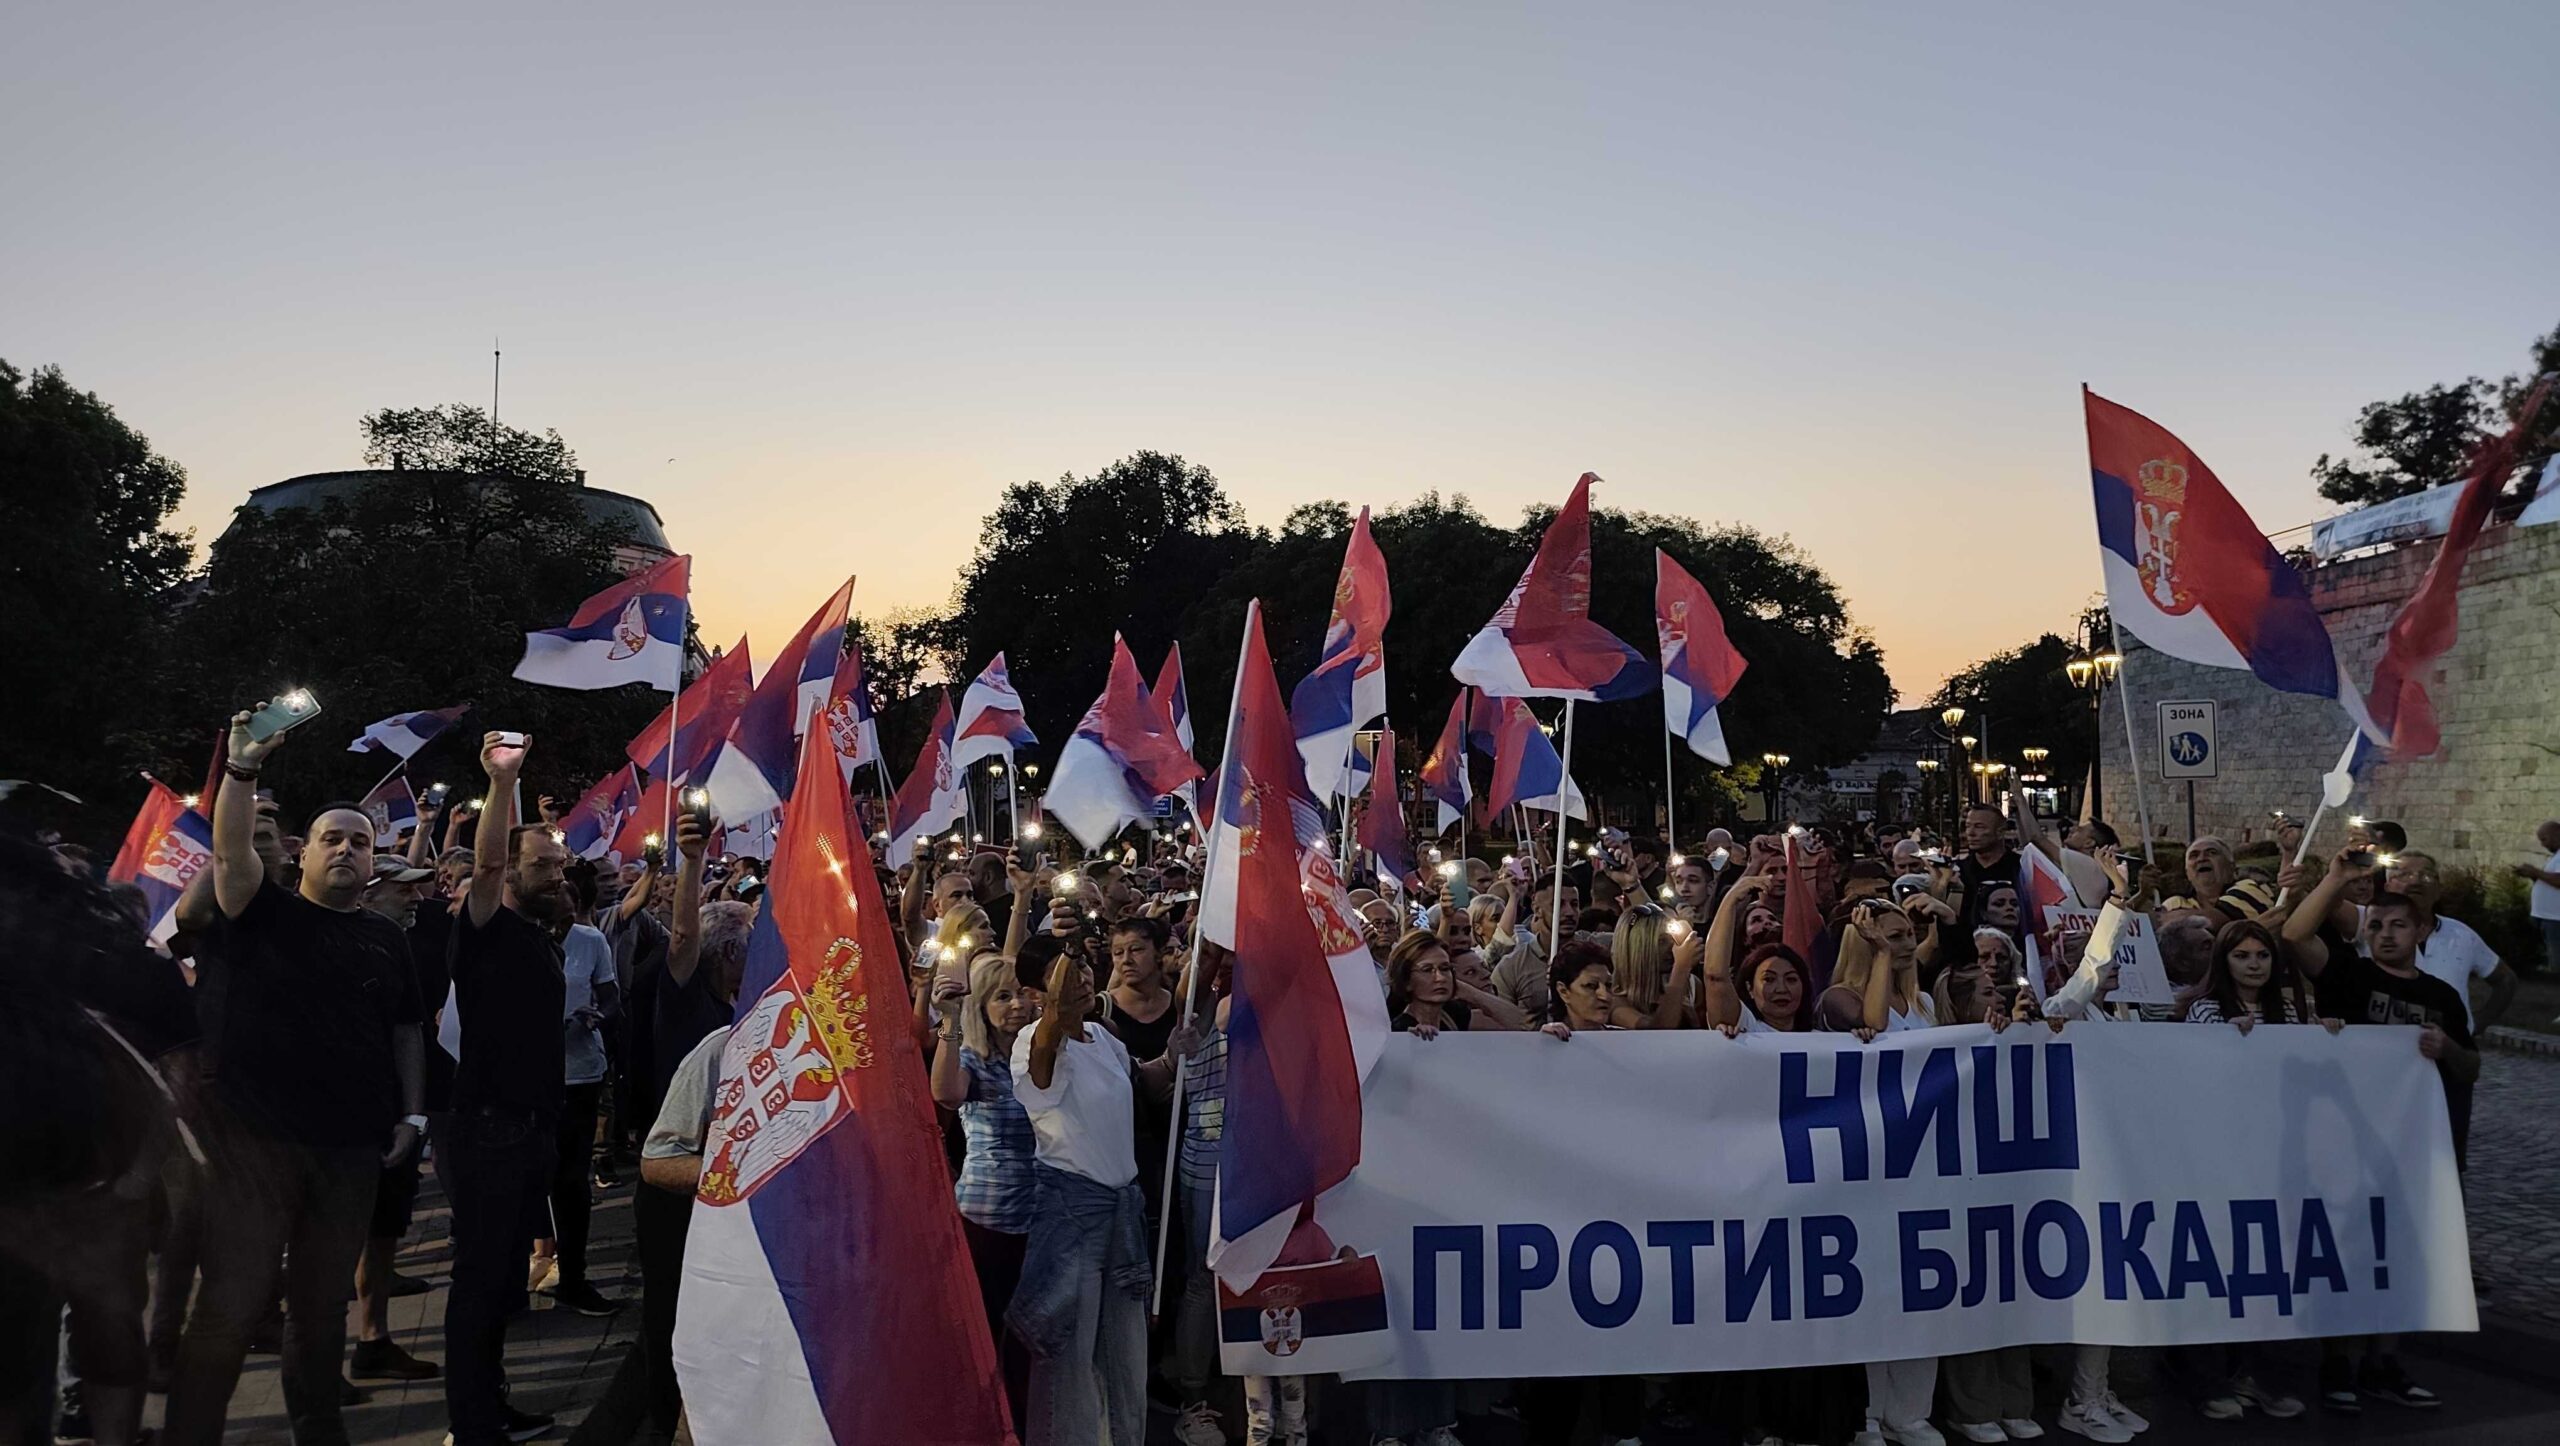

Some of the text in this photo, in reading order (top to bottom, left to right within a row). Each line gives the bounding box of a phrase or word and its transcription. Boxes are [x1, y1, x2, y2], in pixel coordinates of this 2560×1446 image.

[2170, 709, 2205, 720] ЗОНА
[2371, 999, 2434, 1024] HUG
[1779, 1043, 2080, 1183] НИШ
[1413, 1215, 1864, 1331] ПРОТИВ
